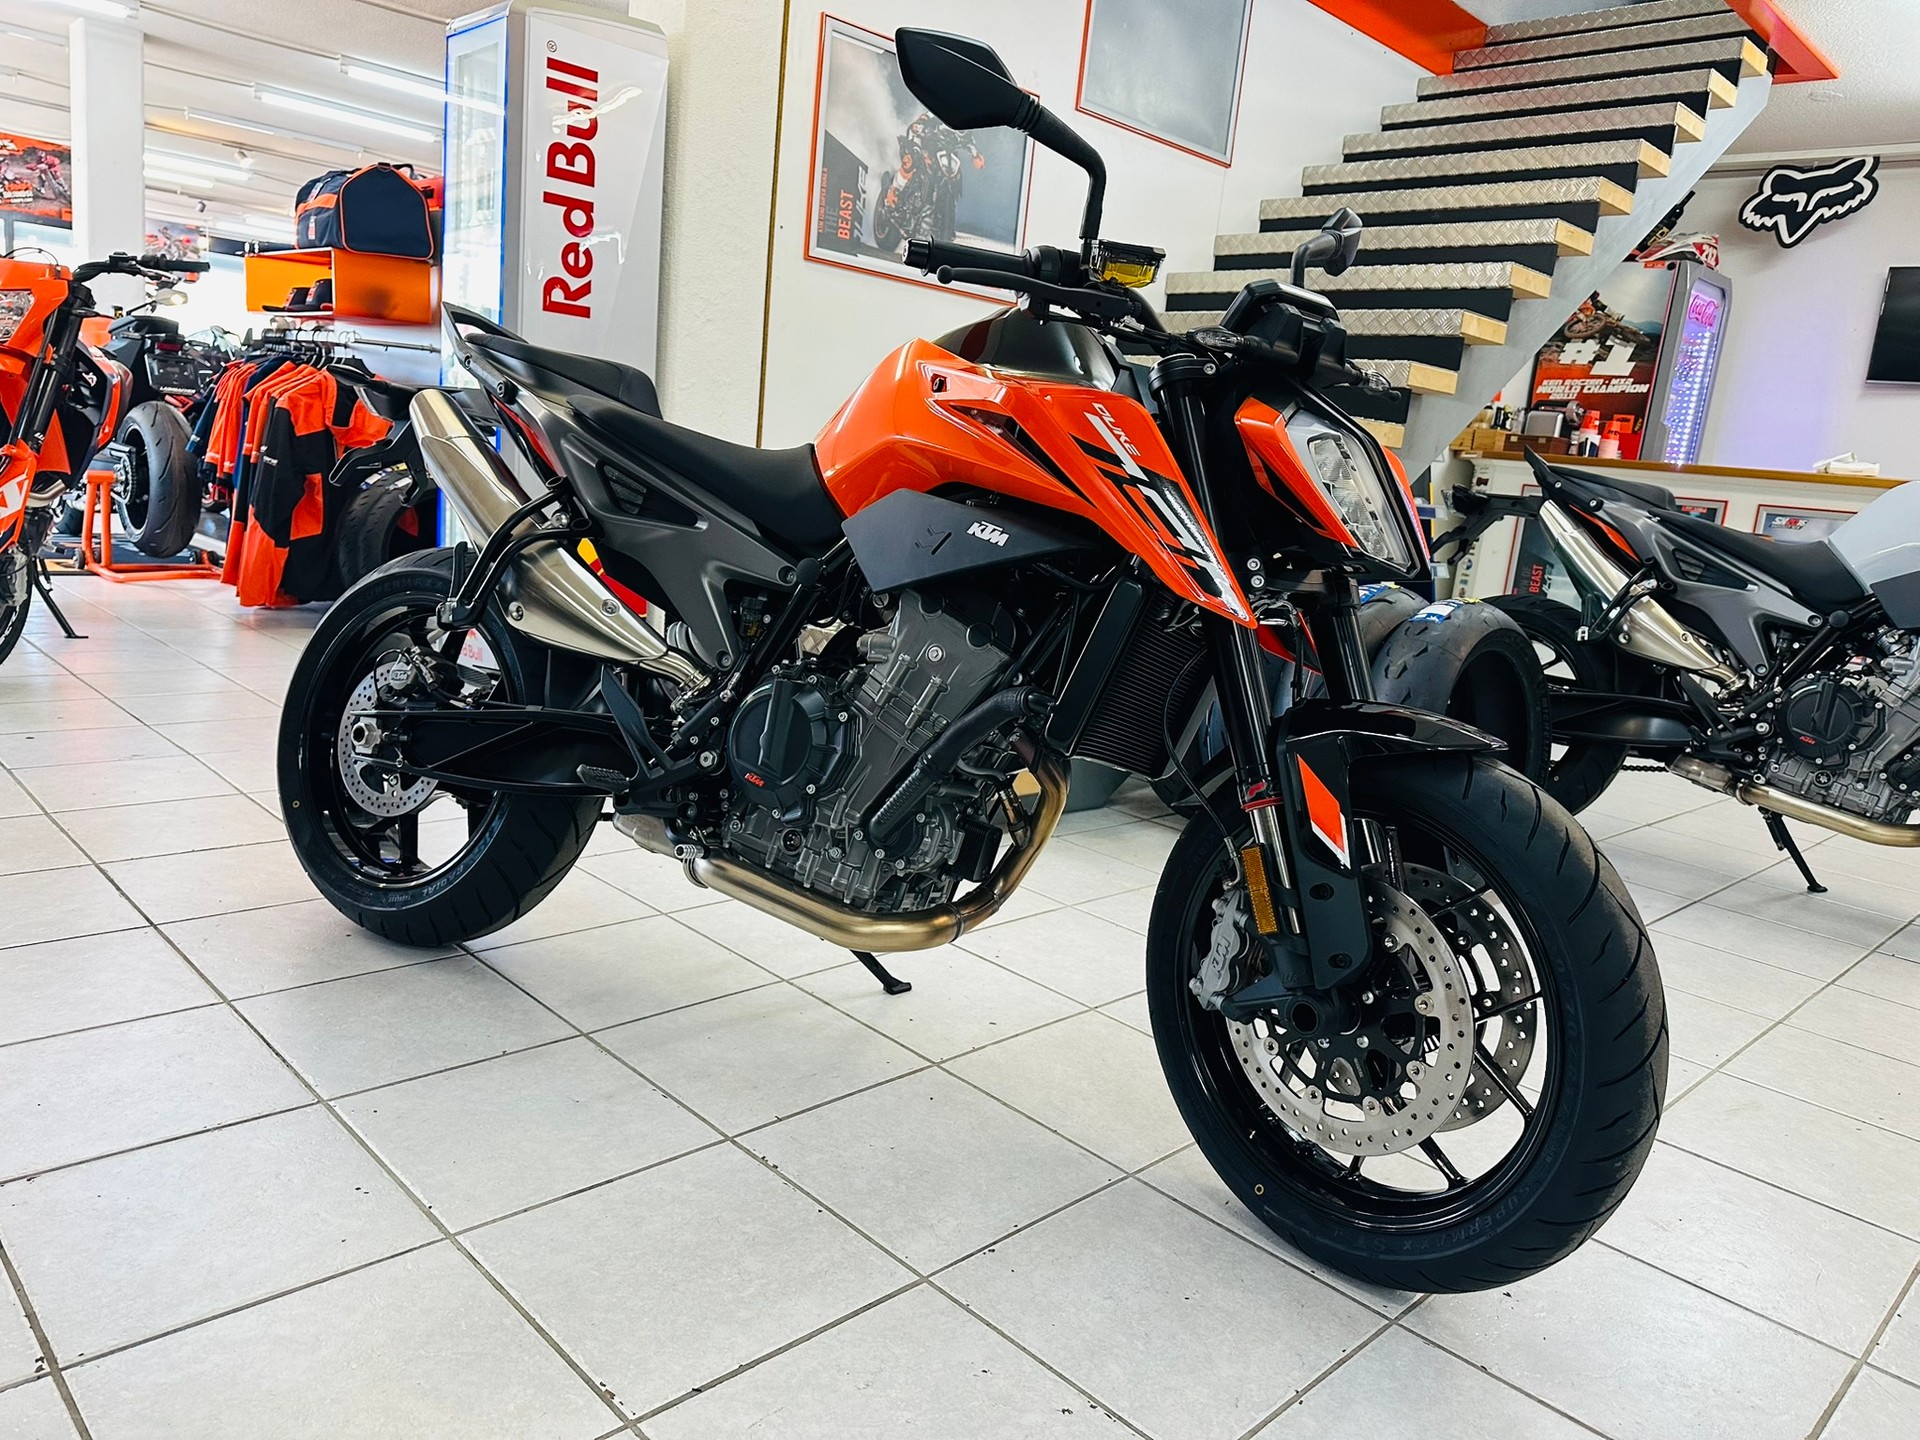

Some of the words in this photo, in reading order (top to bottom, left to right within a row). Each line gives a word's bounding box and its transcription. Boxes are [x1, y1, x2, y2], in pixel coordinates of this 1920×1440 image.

[545, 56, 599, 188] Bull
[838, 190, 853, 239] BEAST
[542, 190, 595, 319] Red
[1536, 385, 1582, 393] WORLD
[1583, 384, 1650, 393] CHAMPION
[1092, 402, 1142, 457] DUKE
[967, 521, 1010, 547] KTM
[1529, 565, 1543, 593] BEAST
[744, 772, 766, 788] KTM
